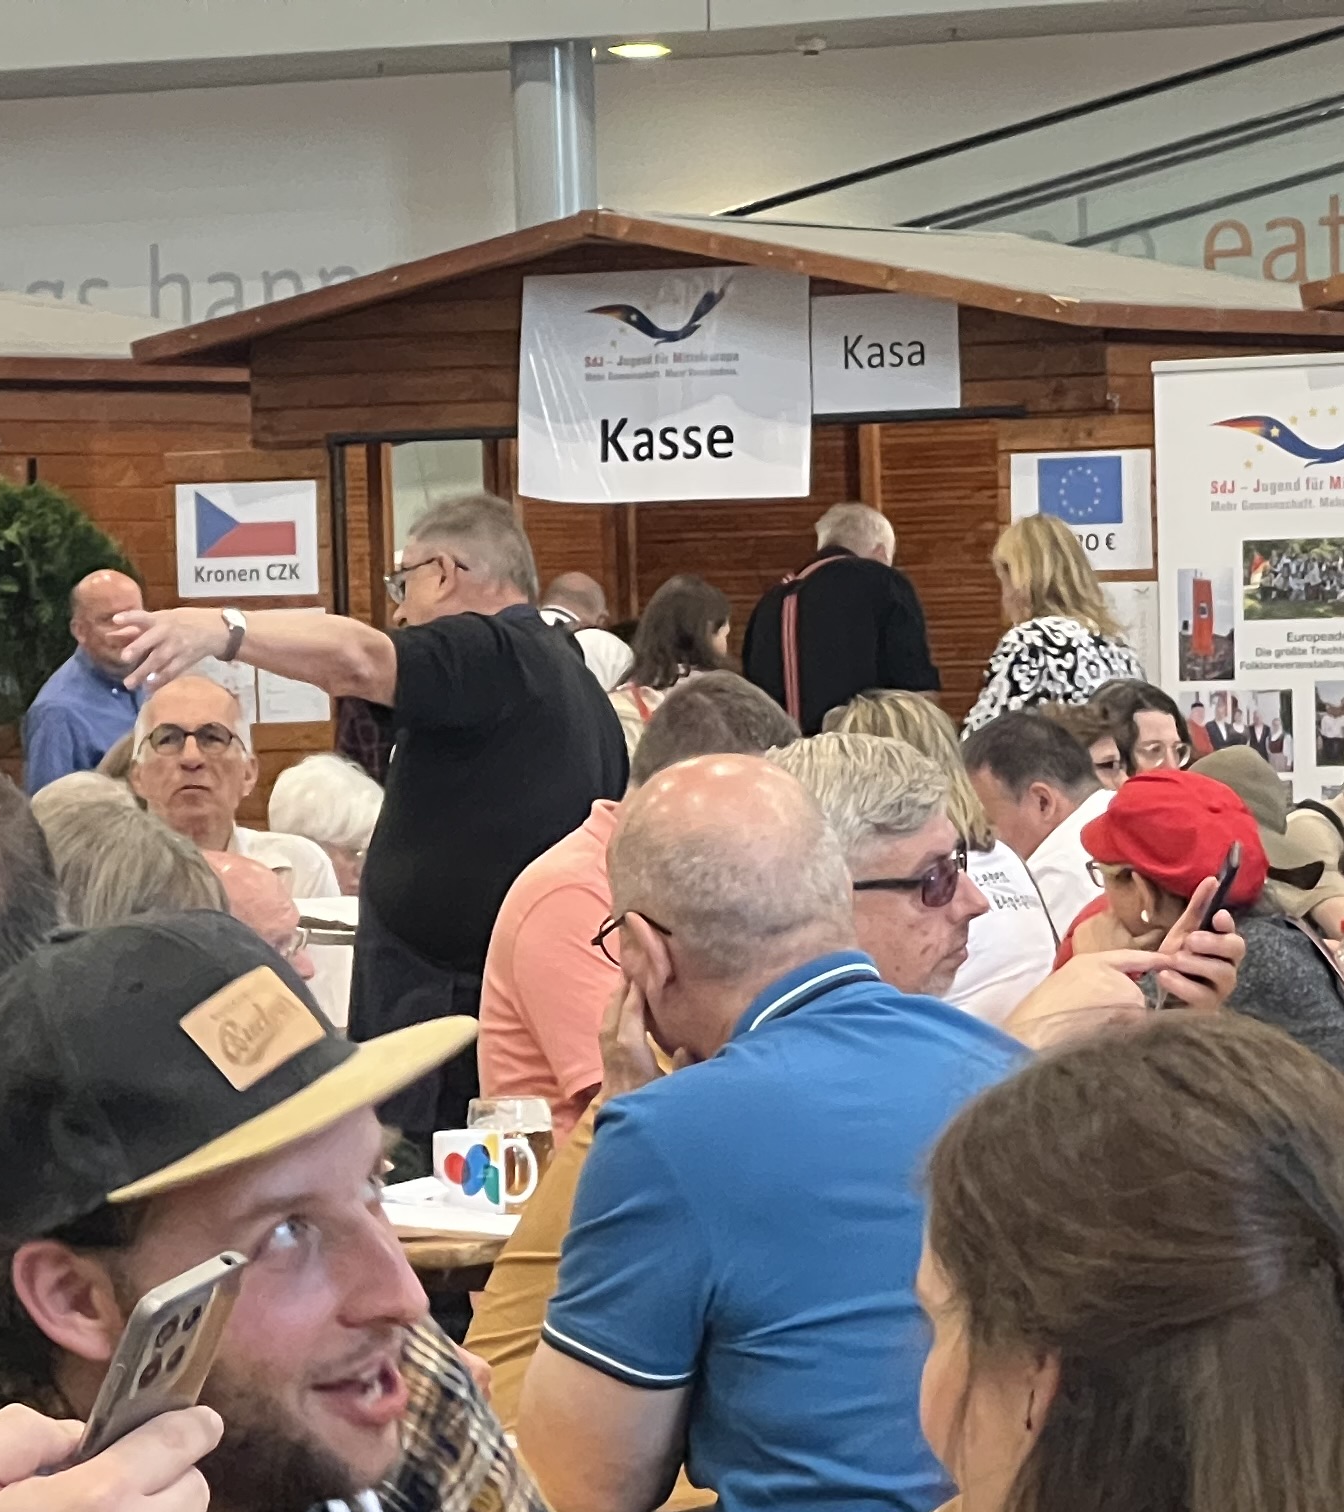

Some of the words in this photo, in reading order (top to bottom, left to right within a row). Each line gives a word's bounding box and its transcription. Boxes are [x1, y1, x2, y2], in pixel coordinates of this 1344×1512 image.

[843, 334, 925, 370] Kasa
[600, 417, 735, 464] Kasse
[1211, 480, 1235, 494] SdJ
[1253, 478, 1301, 496] Jugend
[1305, 476, 1325, 491] für
[194, 564, 260, 583] Kronen
[266, 563, 300, 581] CZK
[1255, 647, 1272, 658] Die
[1274, 646, 1308, 659] größte
